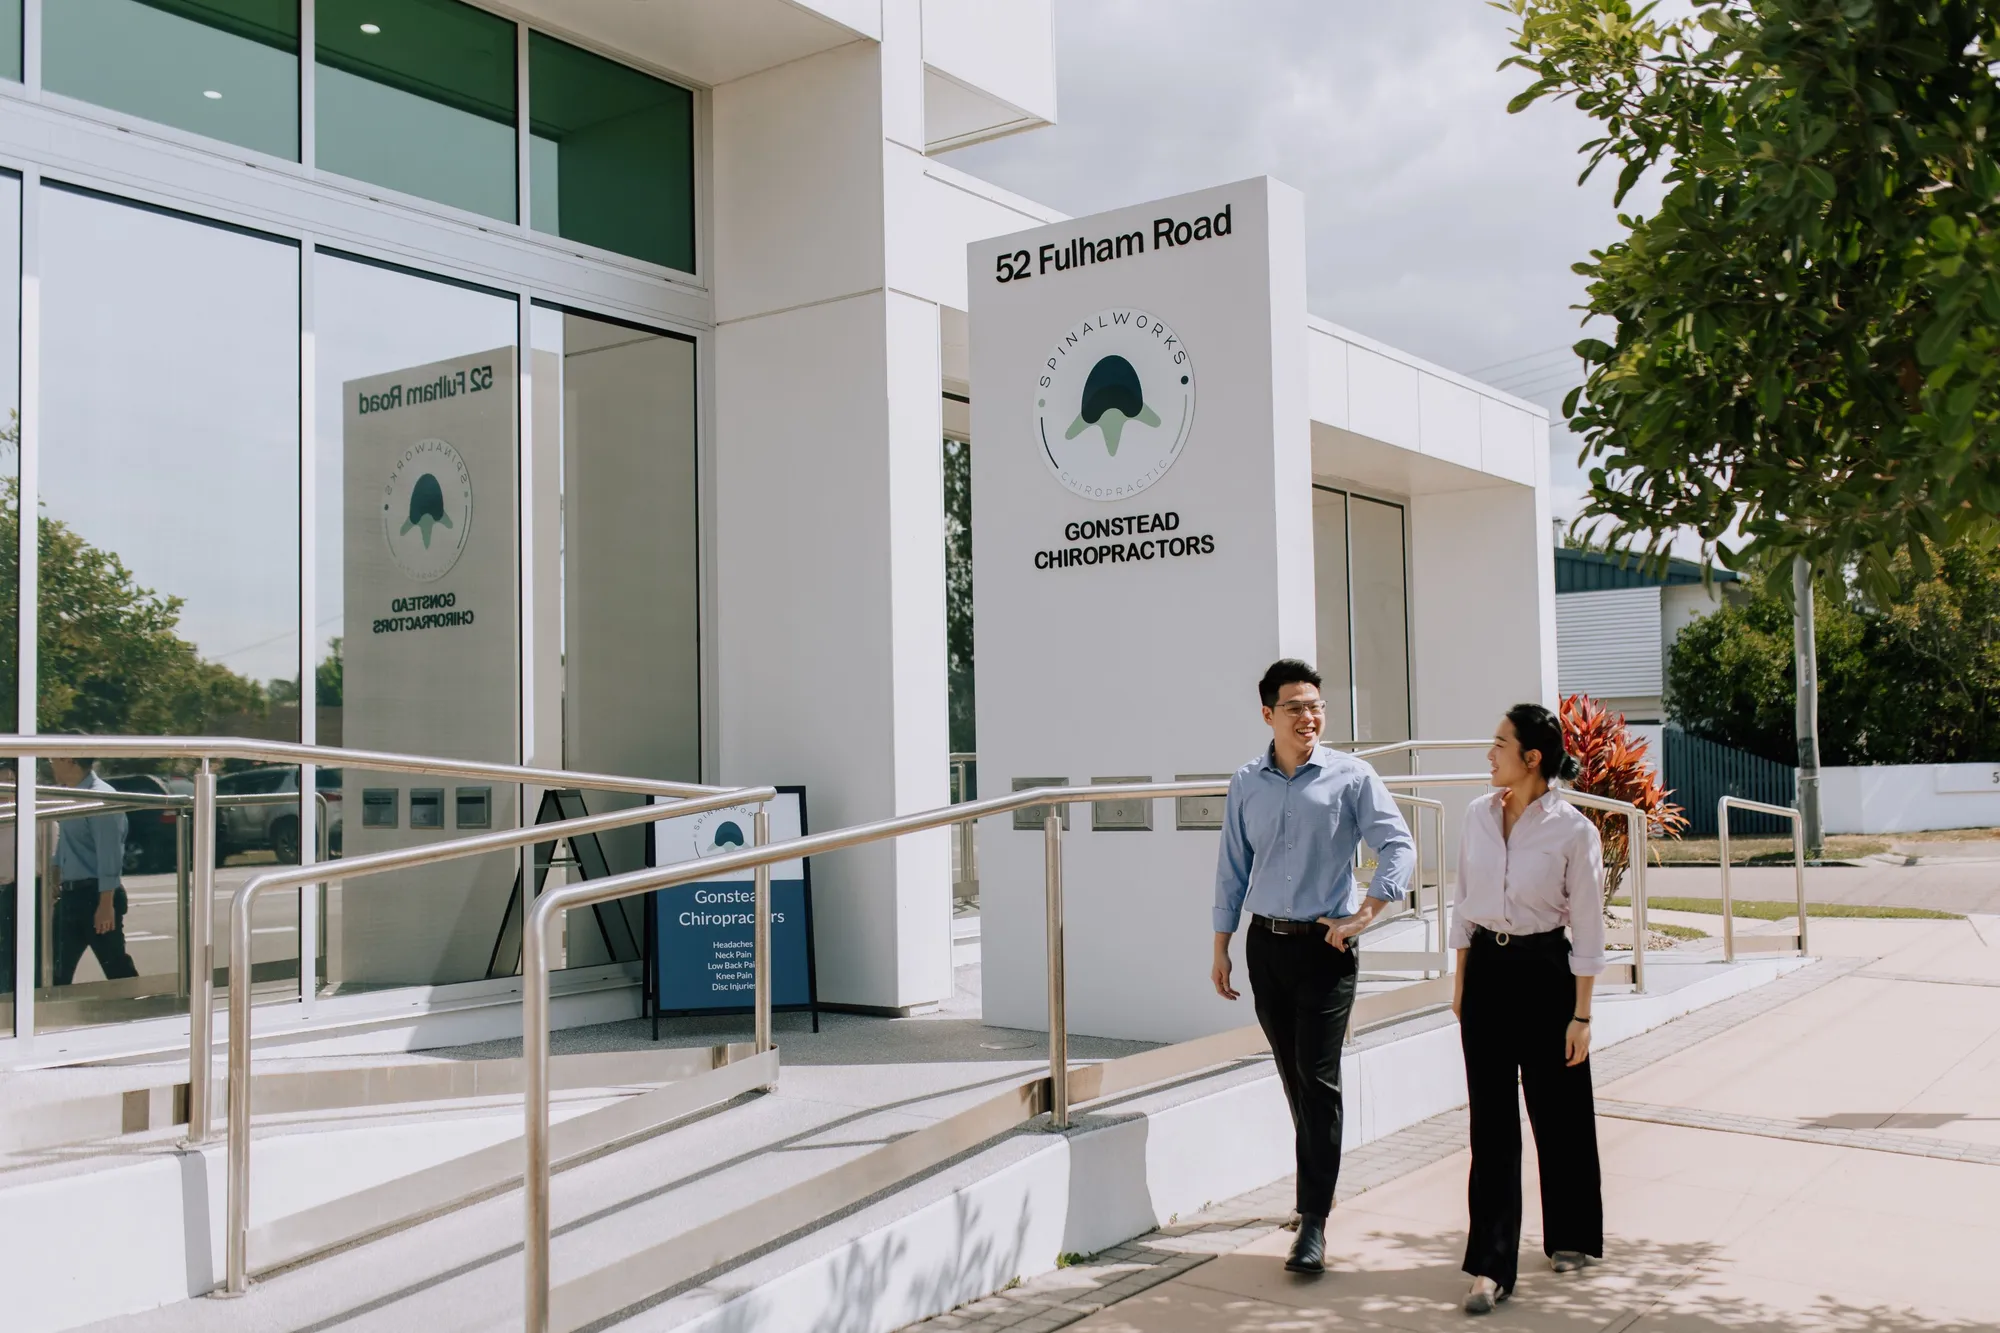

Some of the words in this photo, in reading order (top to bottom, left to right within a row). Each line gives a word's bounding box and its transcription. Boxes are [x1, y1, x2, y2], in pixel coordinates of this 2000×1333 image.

[996, 249, 1031, 284] 52
[1039, 230, 1144, 275] Fulham
[1153, 204, 1233, 251] Road
[1039, 312, 1187, 389] SPINALWORKS
[1061, 459, 1168, 498] CHIROPRACTIC
[1064, 511, 1180, 541] GONSTEAD
[1034, 534, 1215, 570] CHIROPRACTORS
[693, 806, 754, 831] SPINWOR
[694, 890, 756, 904] Gonstea
[679, 912, 785, 928] Chiropracrs
[713, 941, 754, 949] Headaches
[715, 951, 735, 959] Neck
[707, 962, 724, 970] Low
[724, 961, 743, 969] Back
[744, 960, 756, 969] Pai
[715, 972, 736, 980] Knee
[736, 971, 753, 979] Pain
[712, 983, 729, 991] Disc
